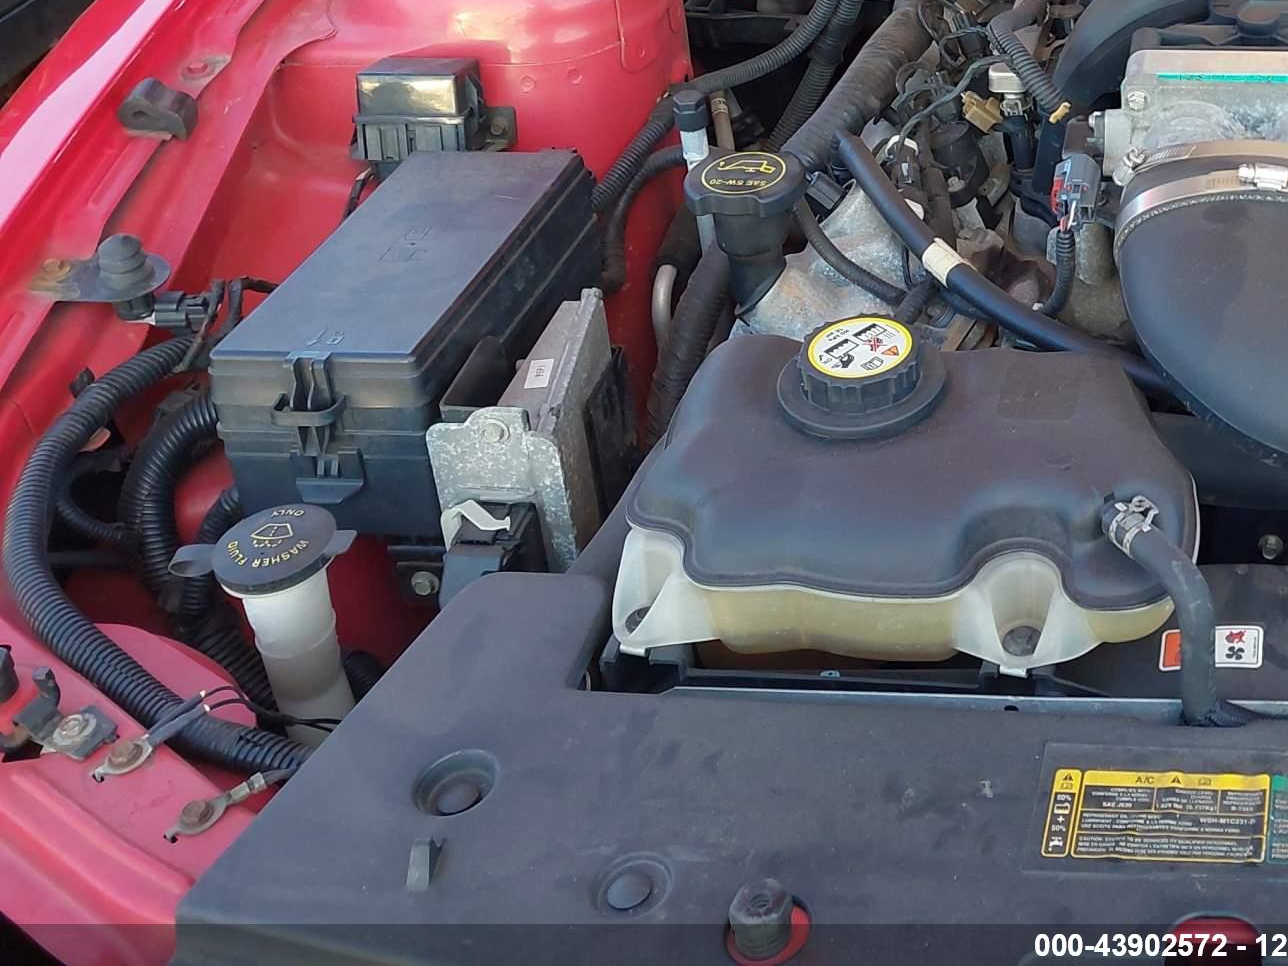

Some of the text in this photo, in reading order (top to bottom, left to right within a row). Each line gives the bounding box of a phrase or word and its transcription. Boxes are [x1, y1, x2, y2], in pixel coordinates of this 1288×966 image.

[744, 179, 767, 187] SAE
[271, 509, 305, 518] ONLY
[227, 539, 309, 568] WASHER FLUID
[1135, 776, 1155, 784] A/C
